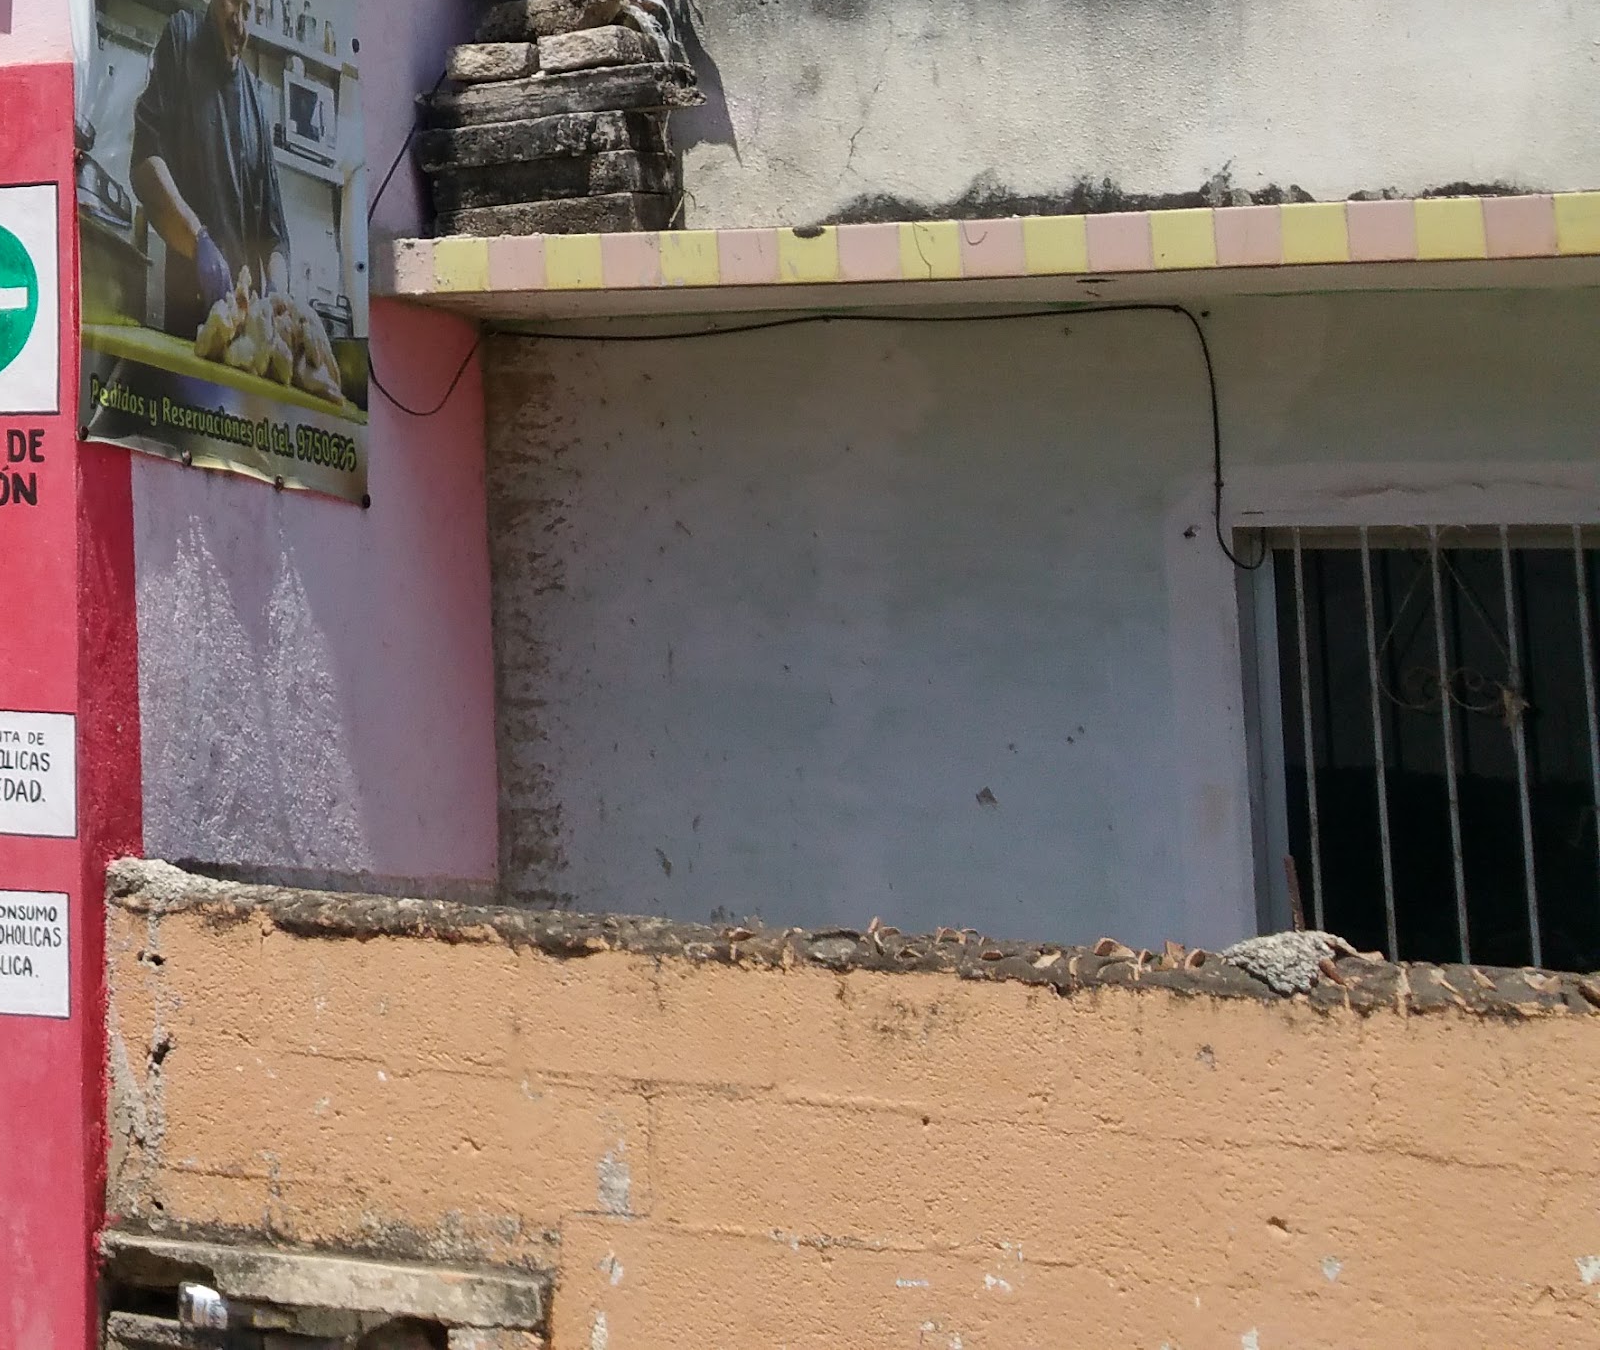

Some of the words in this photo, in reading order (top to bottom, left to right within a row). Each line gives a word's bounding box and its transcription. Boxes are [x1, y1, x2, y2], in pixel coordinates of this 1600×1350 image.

[90, 376, 146, 416] Pedidos
[149, 398, 158, 426] y
[6, 428, 45, 464] DE
[27, 731, 45, 745] DE
